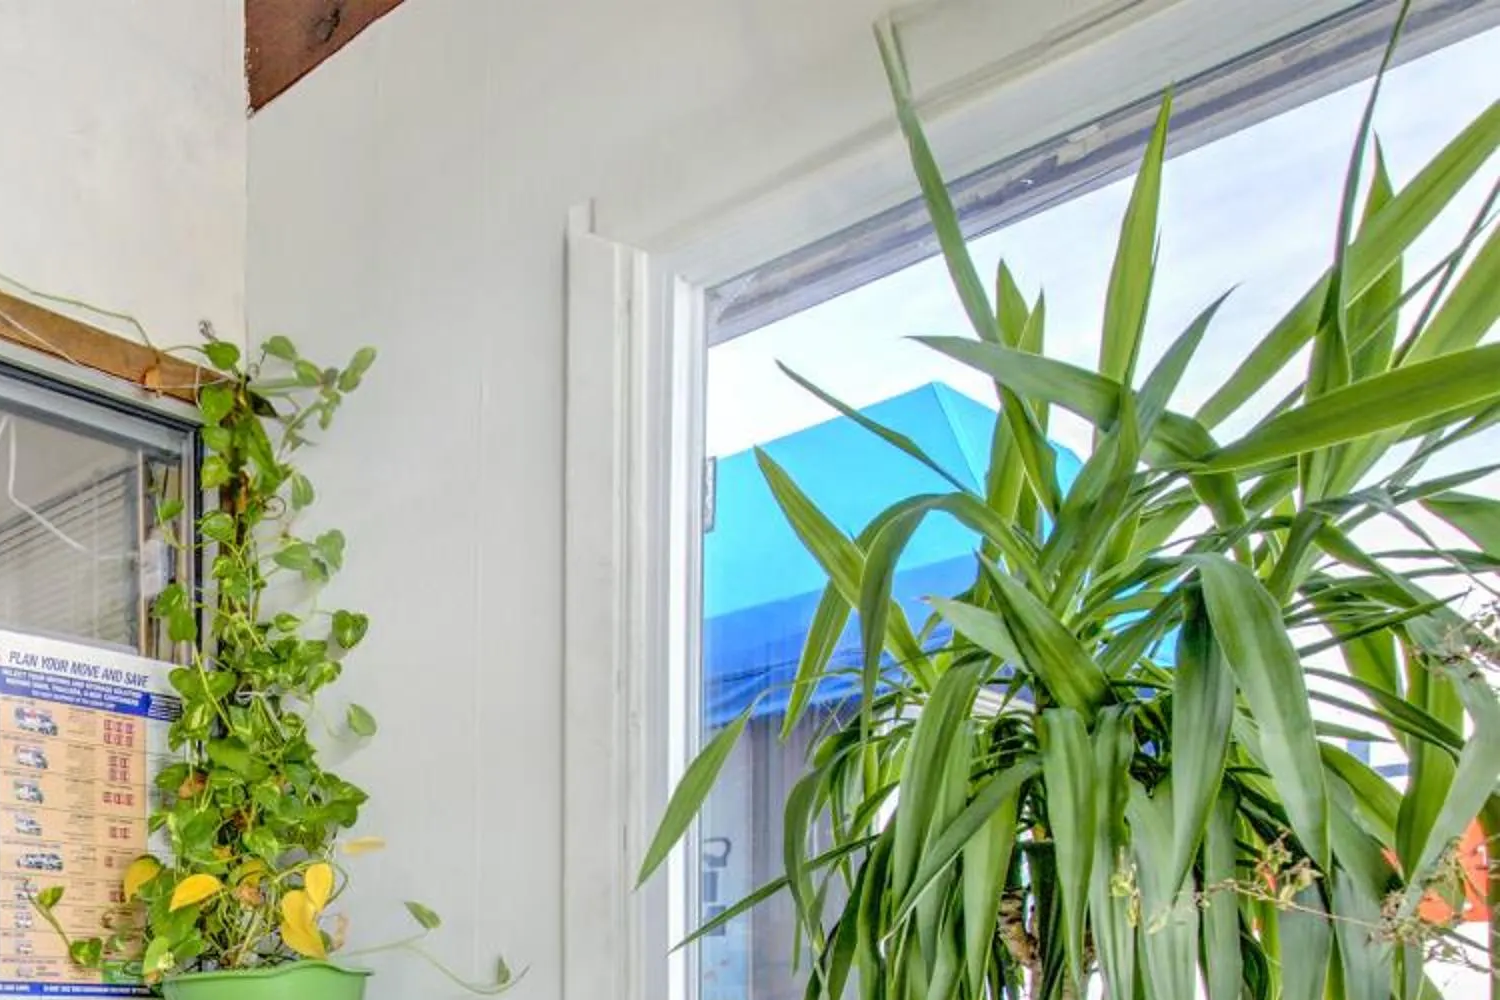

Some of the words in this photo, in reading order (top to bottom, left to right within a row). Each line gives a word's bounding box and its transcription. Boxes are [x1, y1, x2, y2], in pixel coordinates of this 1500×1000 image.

[8, 650, 39, 668] PLAN
[41, 655, 69, 673] YOUR
[69, 660, 101, 679] MOVE
[101, 667, 123, 682] AND
[124, 671, 149, 687] SAVE
